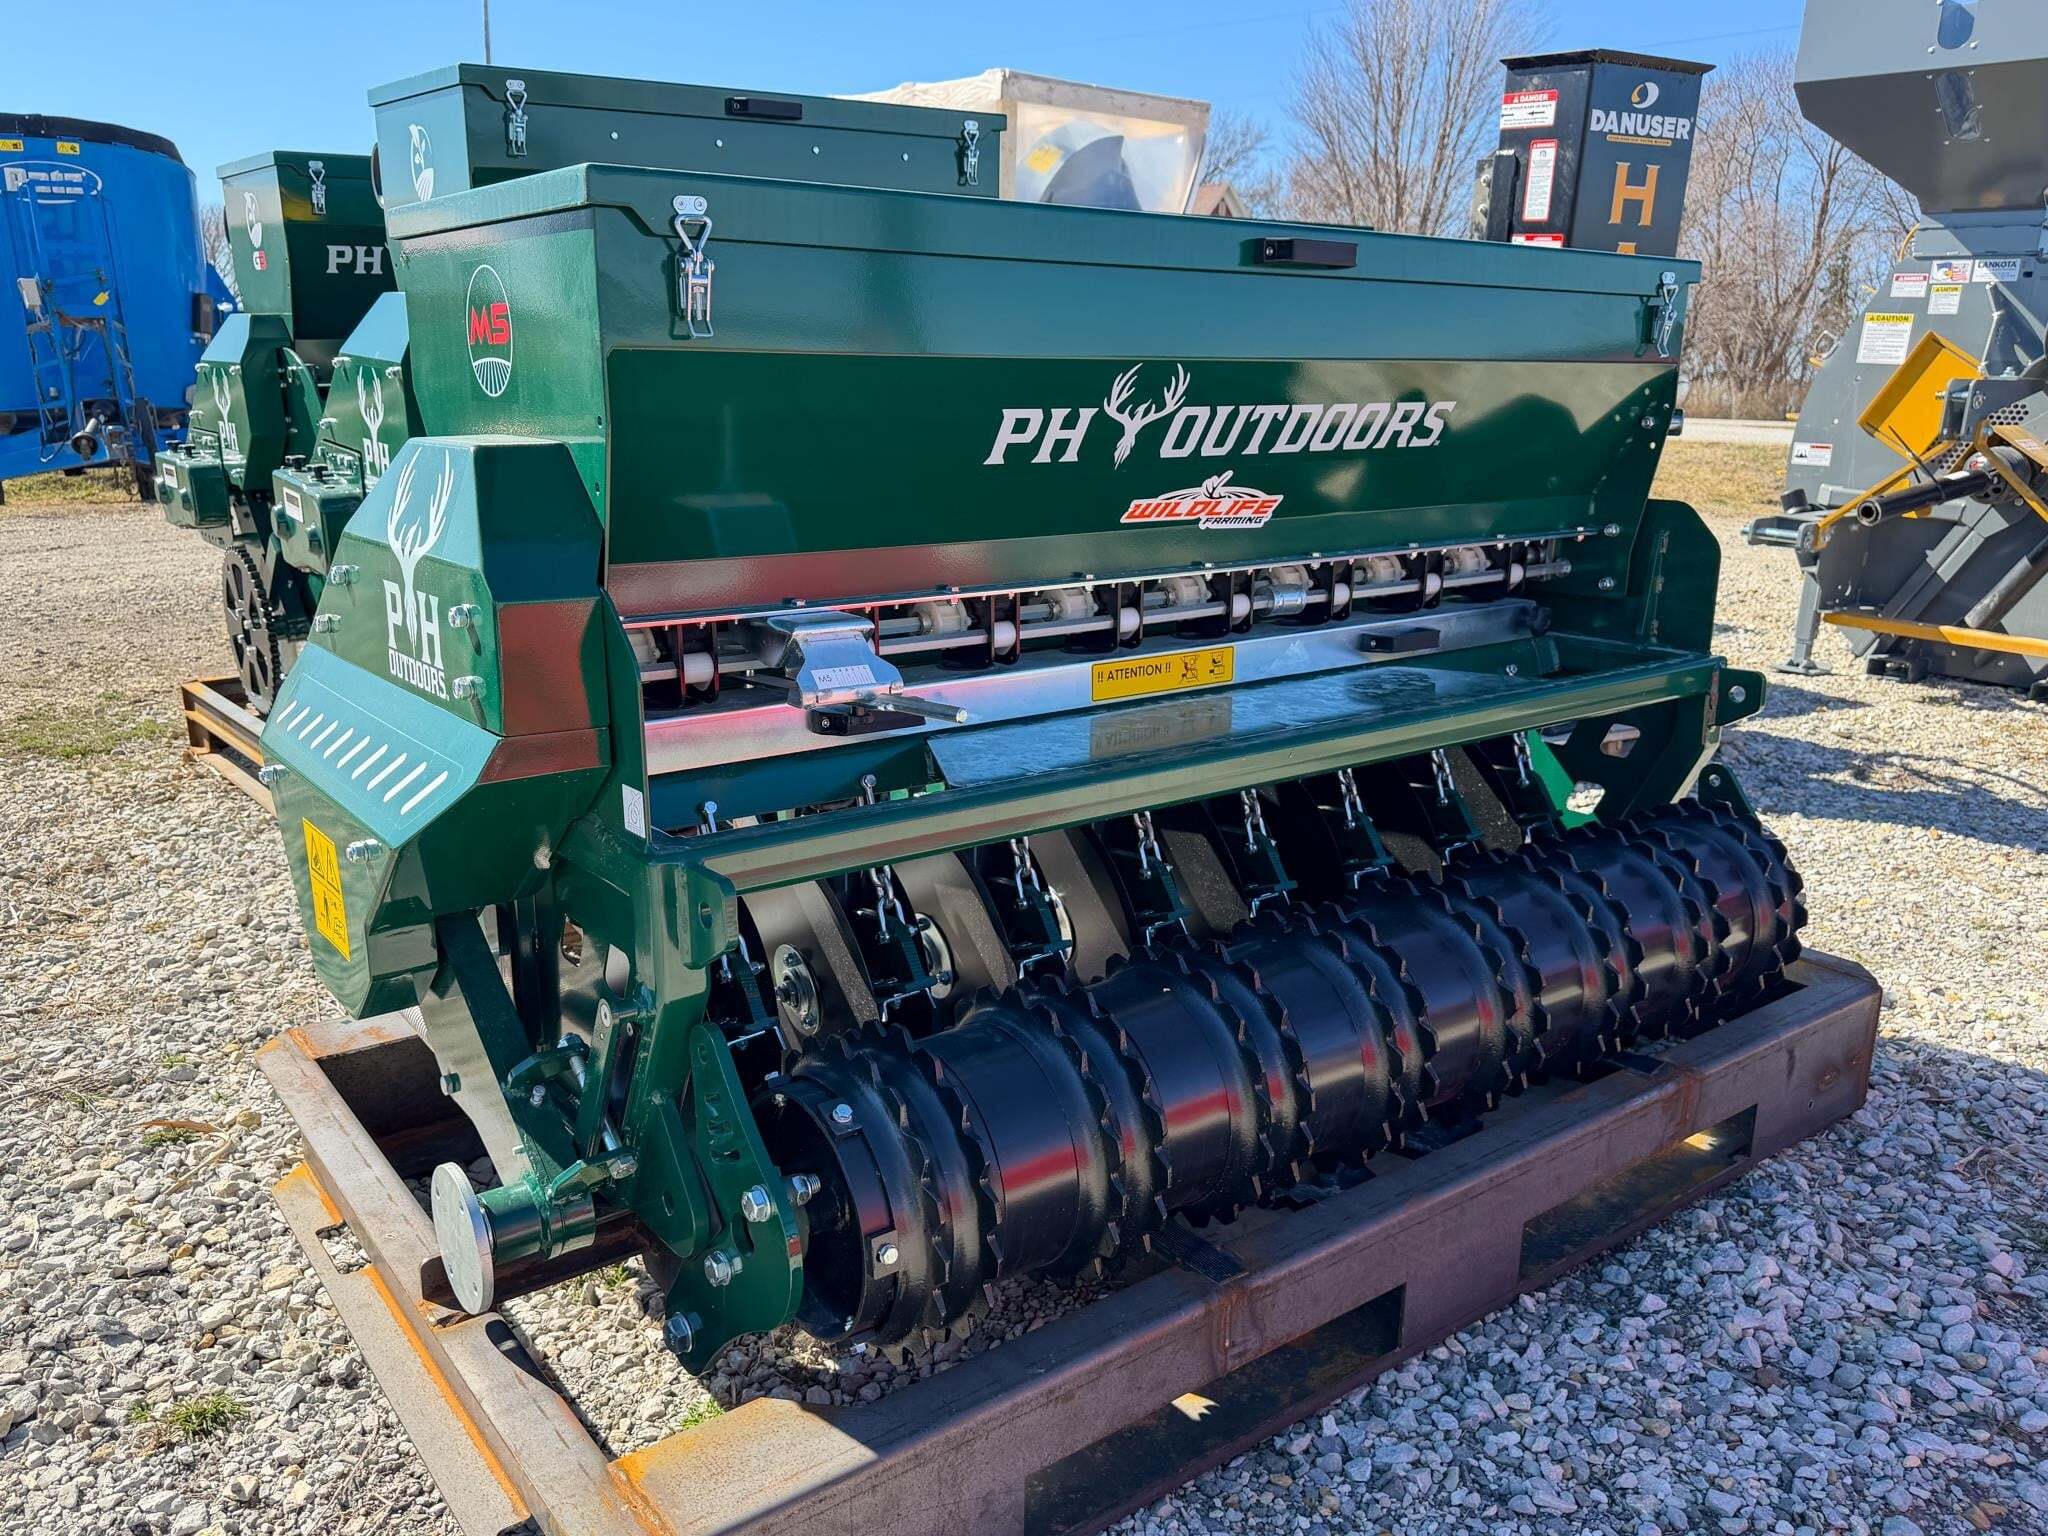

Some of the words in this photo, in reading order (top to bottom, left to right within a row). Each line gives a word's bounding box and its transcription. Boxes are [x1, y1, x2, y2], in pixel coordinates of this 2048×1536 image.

[1519, 93, 1549, 103] DANGER
[1590, 109, 1691, 140] DANUSER
[326, 245, 384, 275] PH
[1977, 260, 2017, 269] LANKOTA
[983, 407, 1099, 465] PH
[1160, 401, 1457, 459] OUTDOORS
[1125, 498, 1280, 520] WILDLIFE
[1203, 516, 1265, 525] FARMING
[383, 579, 444, 669] PH
[388, 647, 449, 701] OUTDOORS
[818, 674, 832, 683] M5
[1106, 663, 1163, 681] ATTENTION
